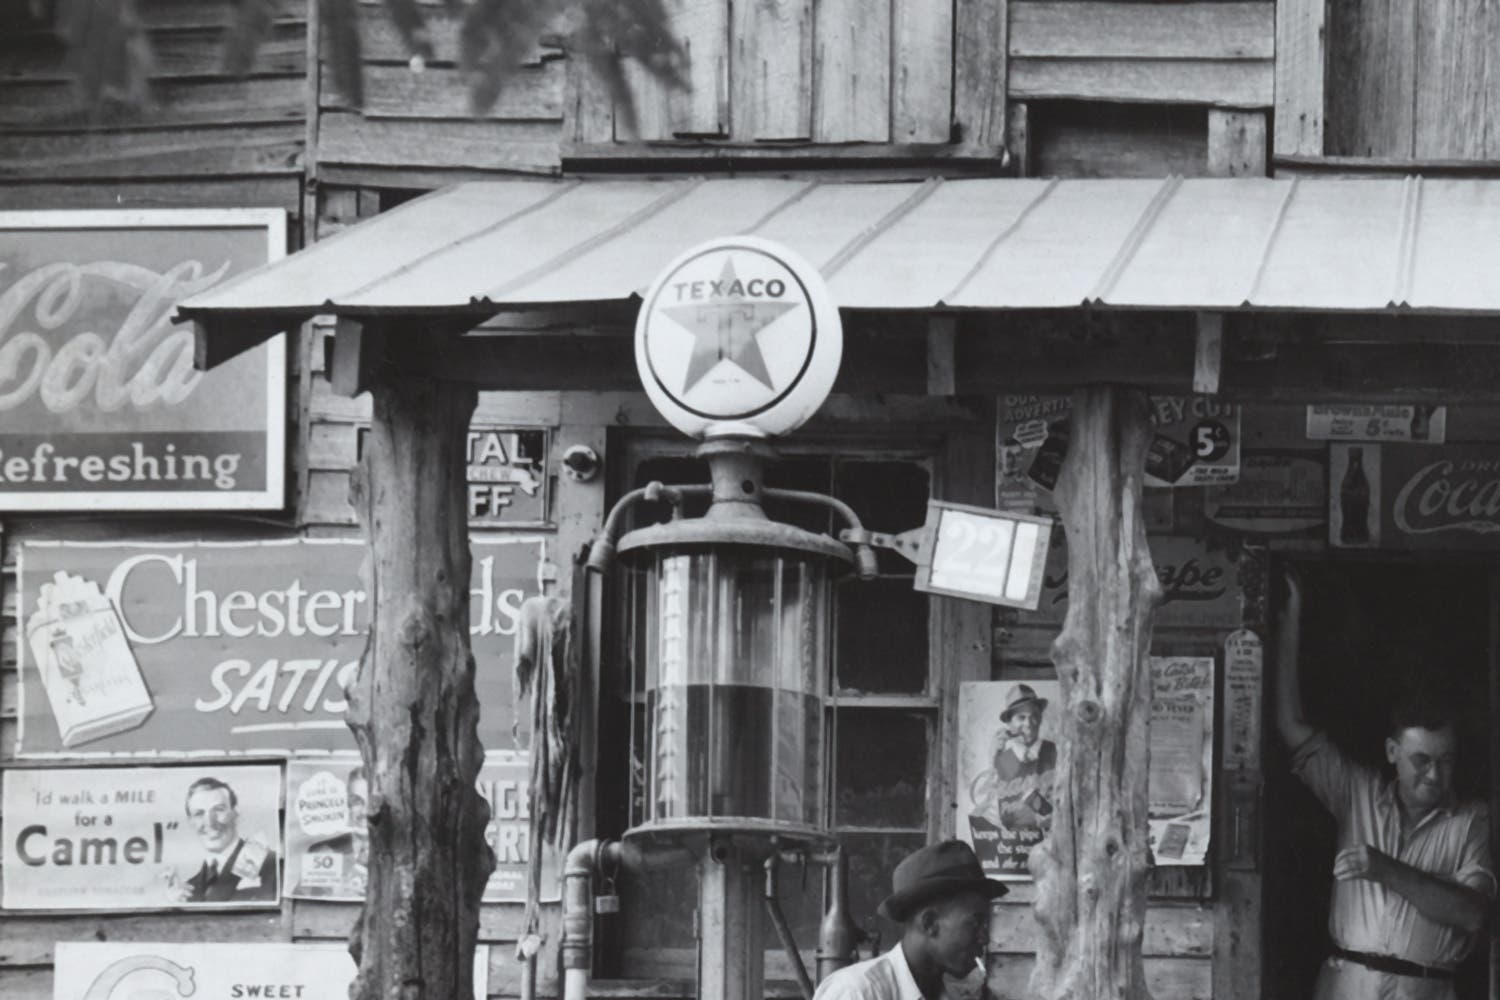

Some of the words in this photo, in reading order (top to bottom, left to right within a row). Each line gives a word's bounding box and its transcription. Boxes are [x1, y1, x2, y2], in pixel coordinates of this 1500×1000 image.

[673, 279, 785, 301] TEXACO
[1004, 397, 1073, 421] ADVERTIS
[467, 432, 533, 463] TAL
[194, 658, 358, 713] SATIS
[59, 790, 95, 805] walk
[99, 792, 109, 804] a
[115, 790, 156, 804] MILE
[75, 811, 98, 827] for
[104, 814, 114, 827] a
[231, 983, 306, 998] SWEET
